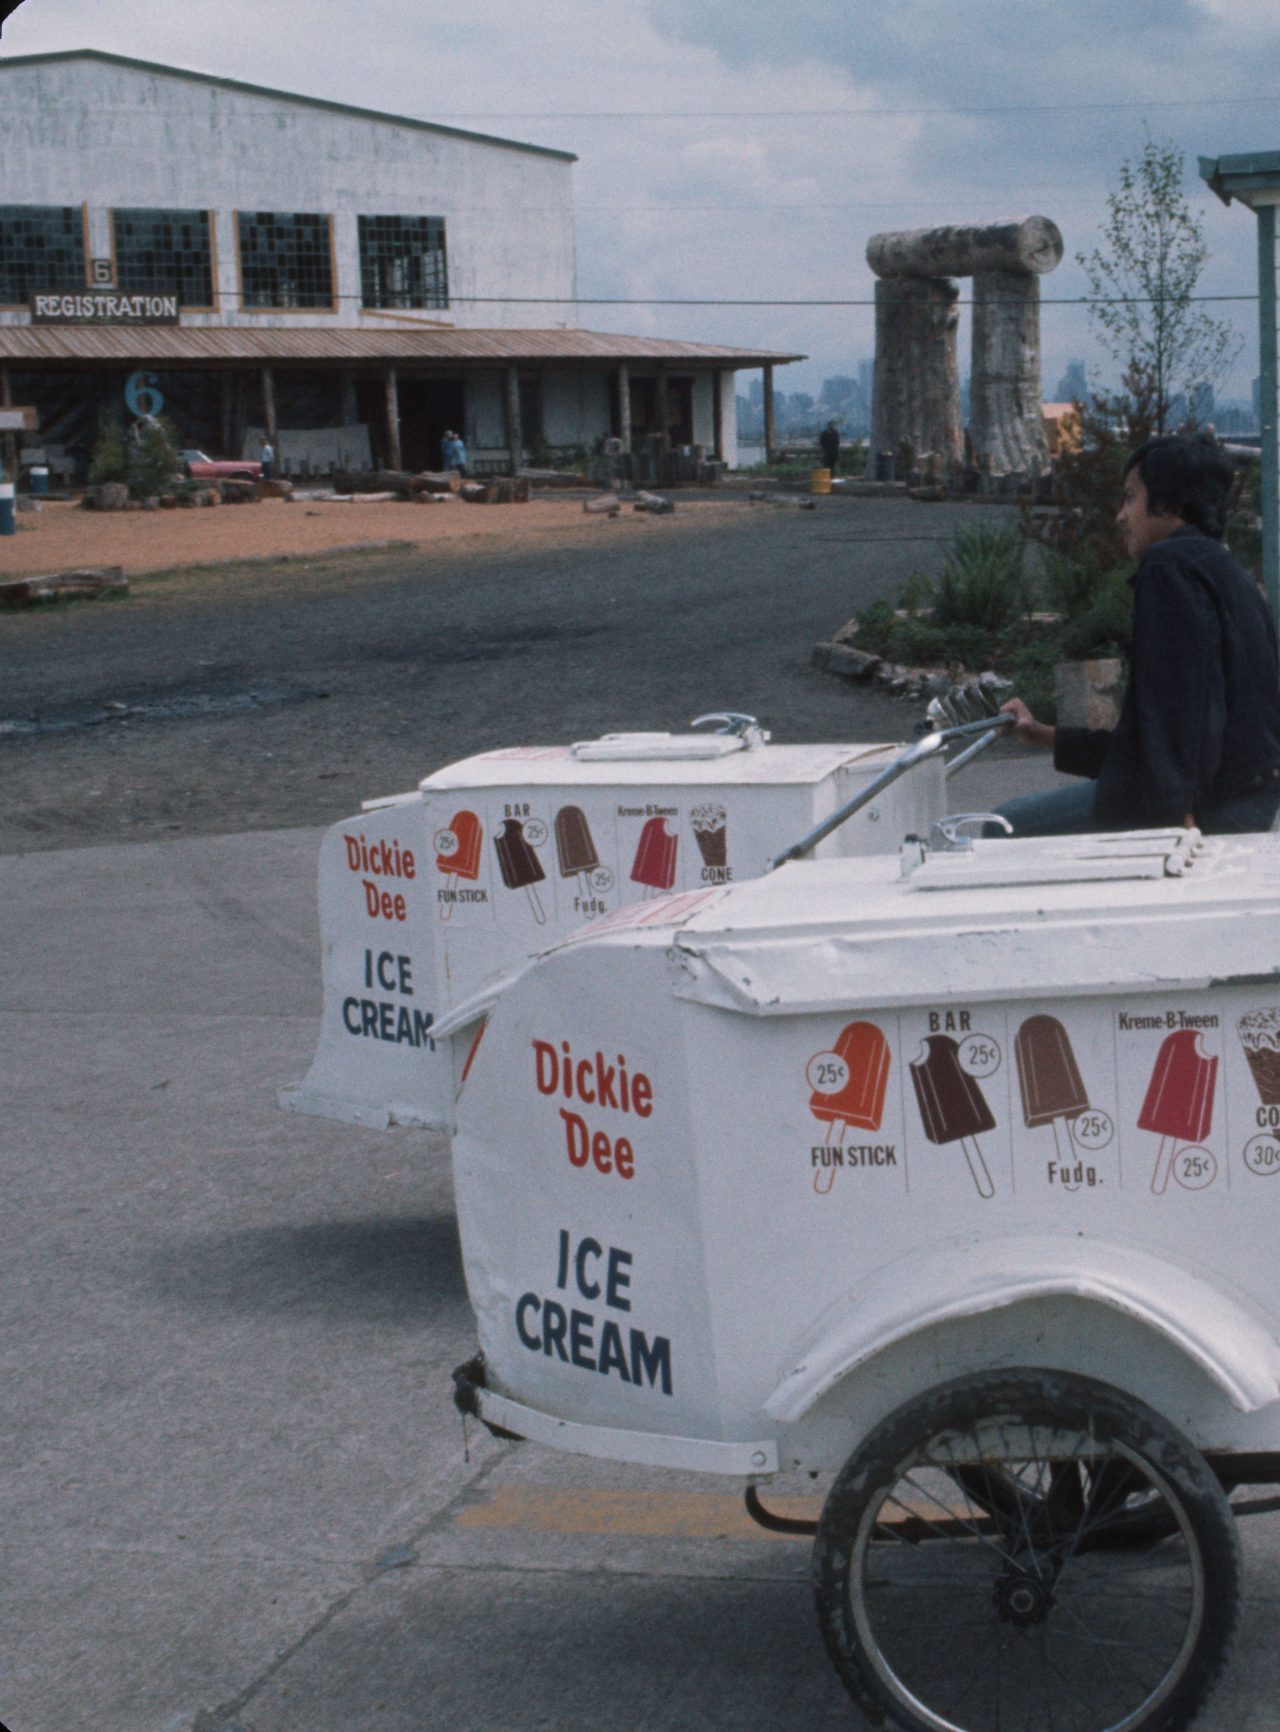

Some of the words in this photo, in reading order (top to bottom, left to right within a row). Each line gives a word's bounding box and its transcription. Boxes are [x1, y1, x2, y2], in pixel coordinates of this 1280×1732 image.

[94, 260, 112, 283] 6
[35, 295, 177, 318] REGISTRATION
[125, 370, 164, 418] 6
[503, 803, 531, 818] BAR
[617, 804, 678, 817] Kreme-B-Tween
[344, 833, 416, 880] Dickie
[701, 867, 733, 881] CONE
[362, 879, 407, 922] Dee
[437, 889, 457, 903] FUN
[458, 889, 488, 903] STICK
[365, 948, 414, 996] ICE
[342, 996, 436, 1052] CREAM
[929, 1010, 972, 1032] BAR
[1118, 1011, 1220, 1030] Kreme-B-Tween
[532, 1038, 654, 1118] Dickie
[559, 1106, 635, 1180] Dee
[811, 1146, 844, 1167] FUN
[847, 1145, 897, 1167] STICK
[556, 1228, 633, 1312] ICE
[515, 1291, 674, 1397] CREAM
